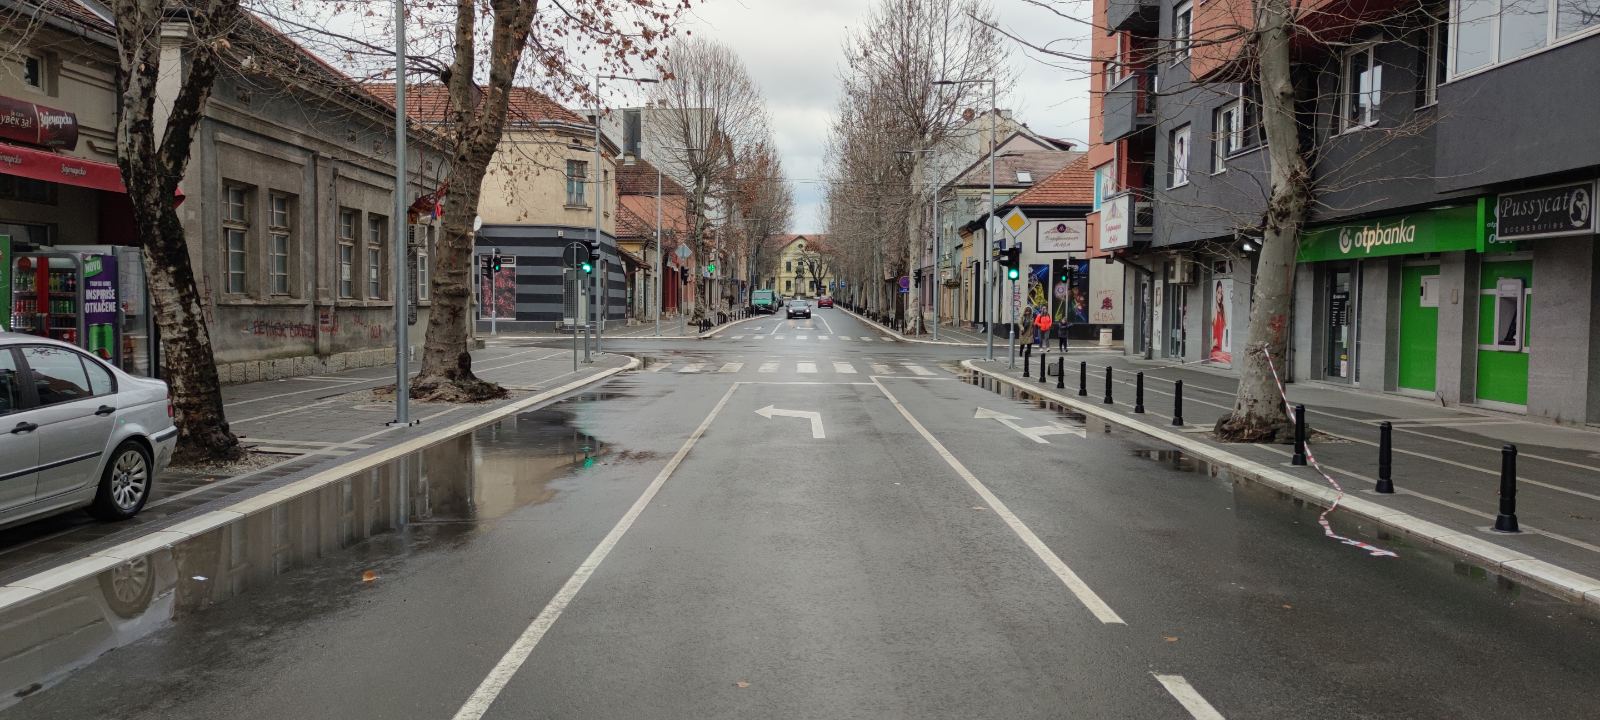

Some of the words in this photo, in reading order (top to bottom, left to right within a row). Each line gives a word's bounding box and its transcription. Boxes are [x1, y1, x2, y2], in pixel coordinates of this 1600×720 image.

[1501, 191, 1570, 222] Pussycat
[1354, 218, 1416, 254] otpbanka
[84, 259, 101, 272] NOVO
[85, 286, 116, 300] INSPIRIŠE
[84, 300, 117, 313] OTKAČENE
